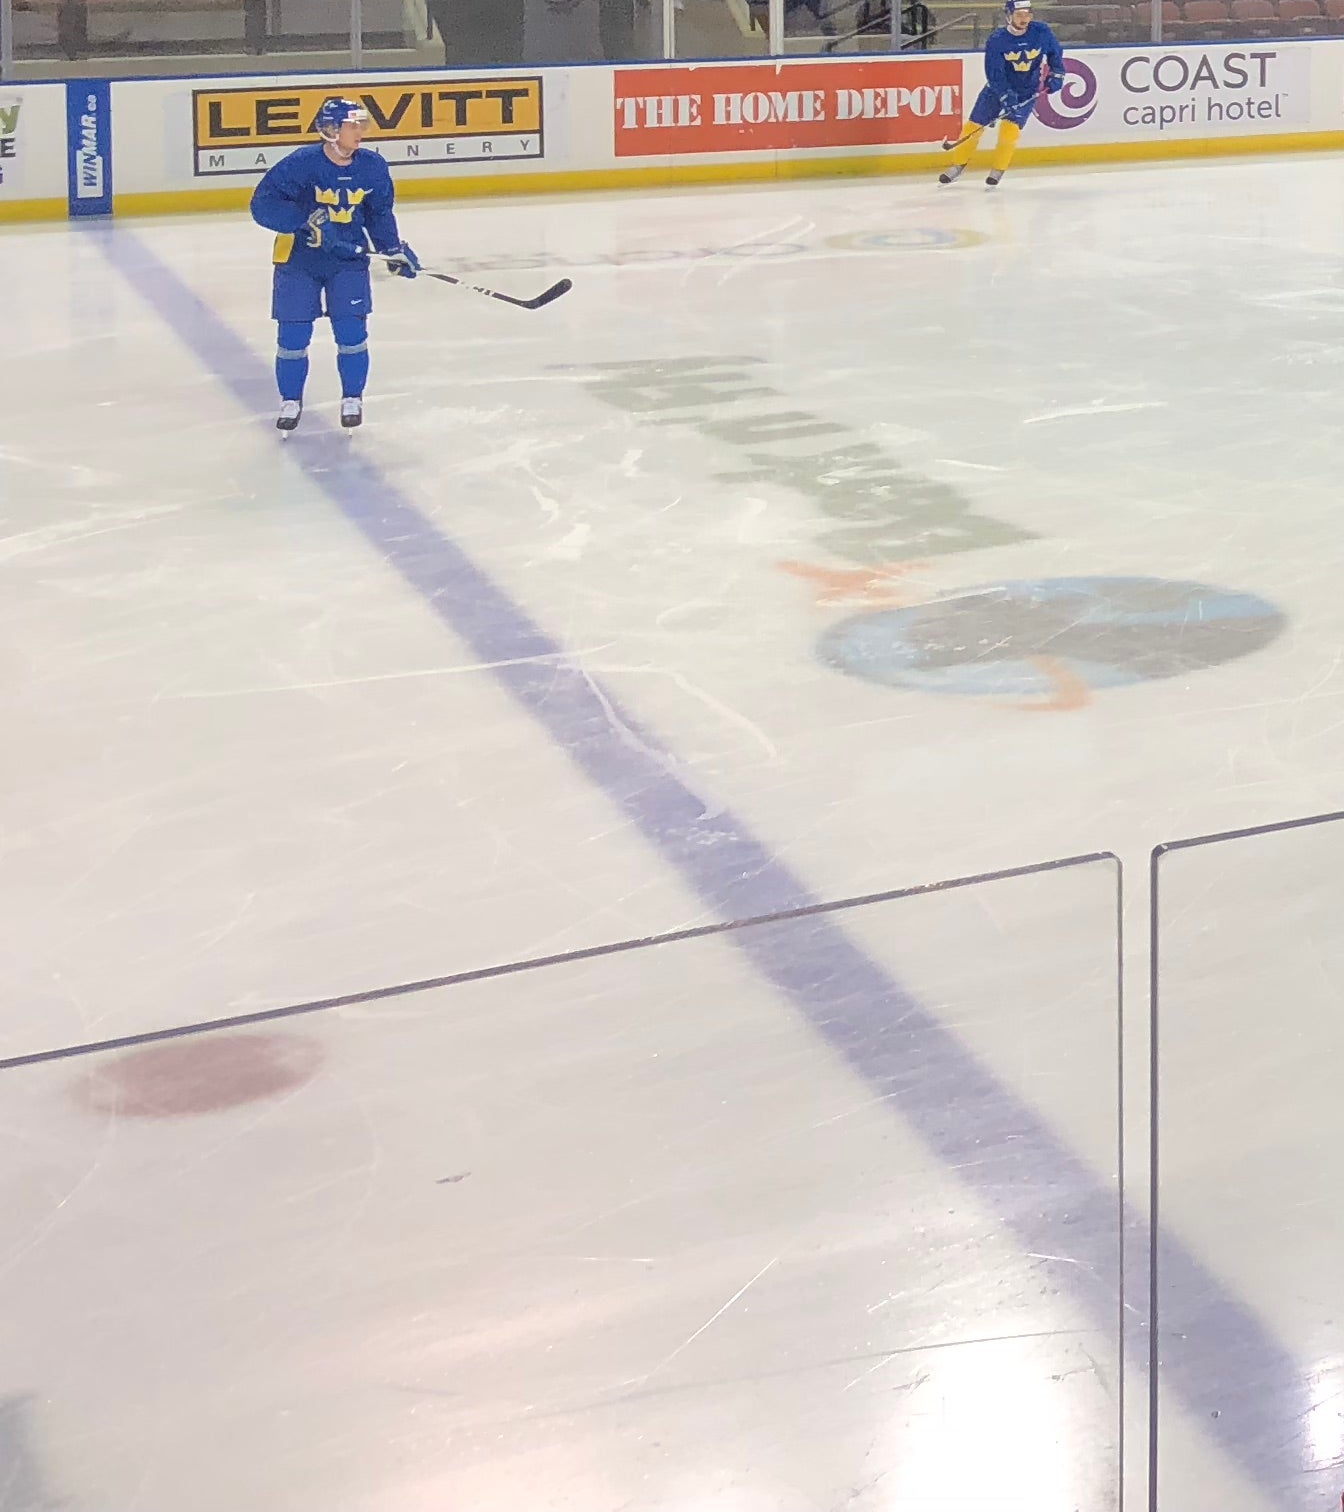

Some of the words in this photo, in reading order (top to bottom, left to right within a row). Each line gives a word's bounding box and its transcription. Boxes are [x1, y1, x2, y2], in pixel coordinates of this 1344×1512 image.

[1120, 51, 1277, 94] COAST
[617, 95, 701, 129] THE
[713, 90, 826, 125] HOME
[835, 85, 960, 120] DEPOT
[1123, 96, 1195, 130] capri
[1207, 94, 1282, 121] hotel
[209, 139, 531, 167] MAINERY
